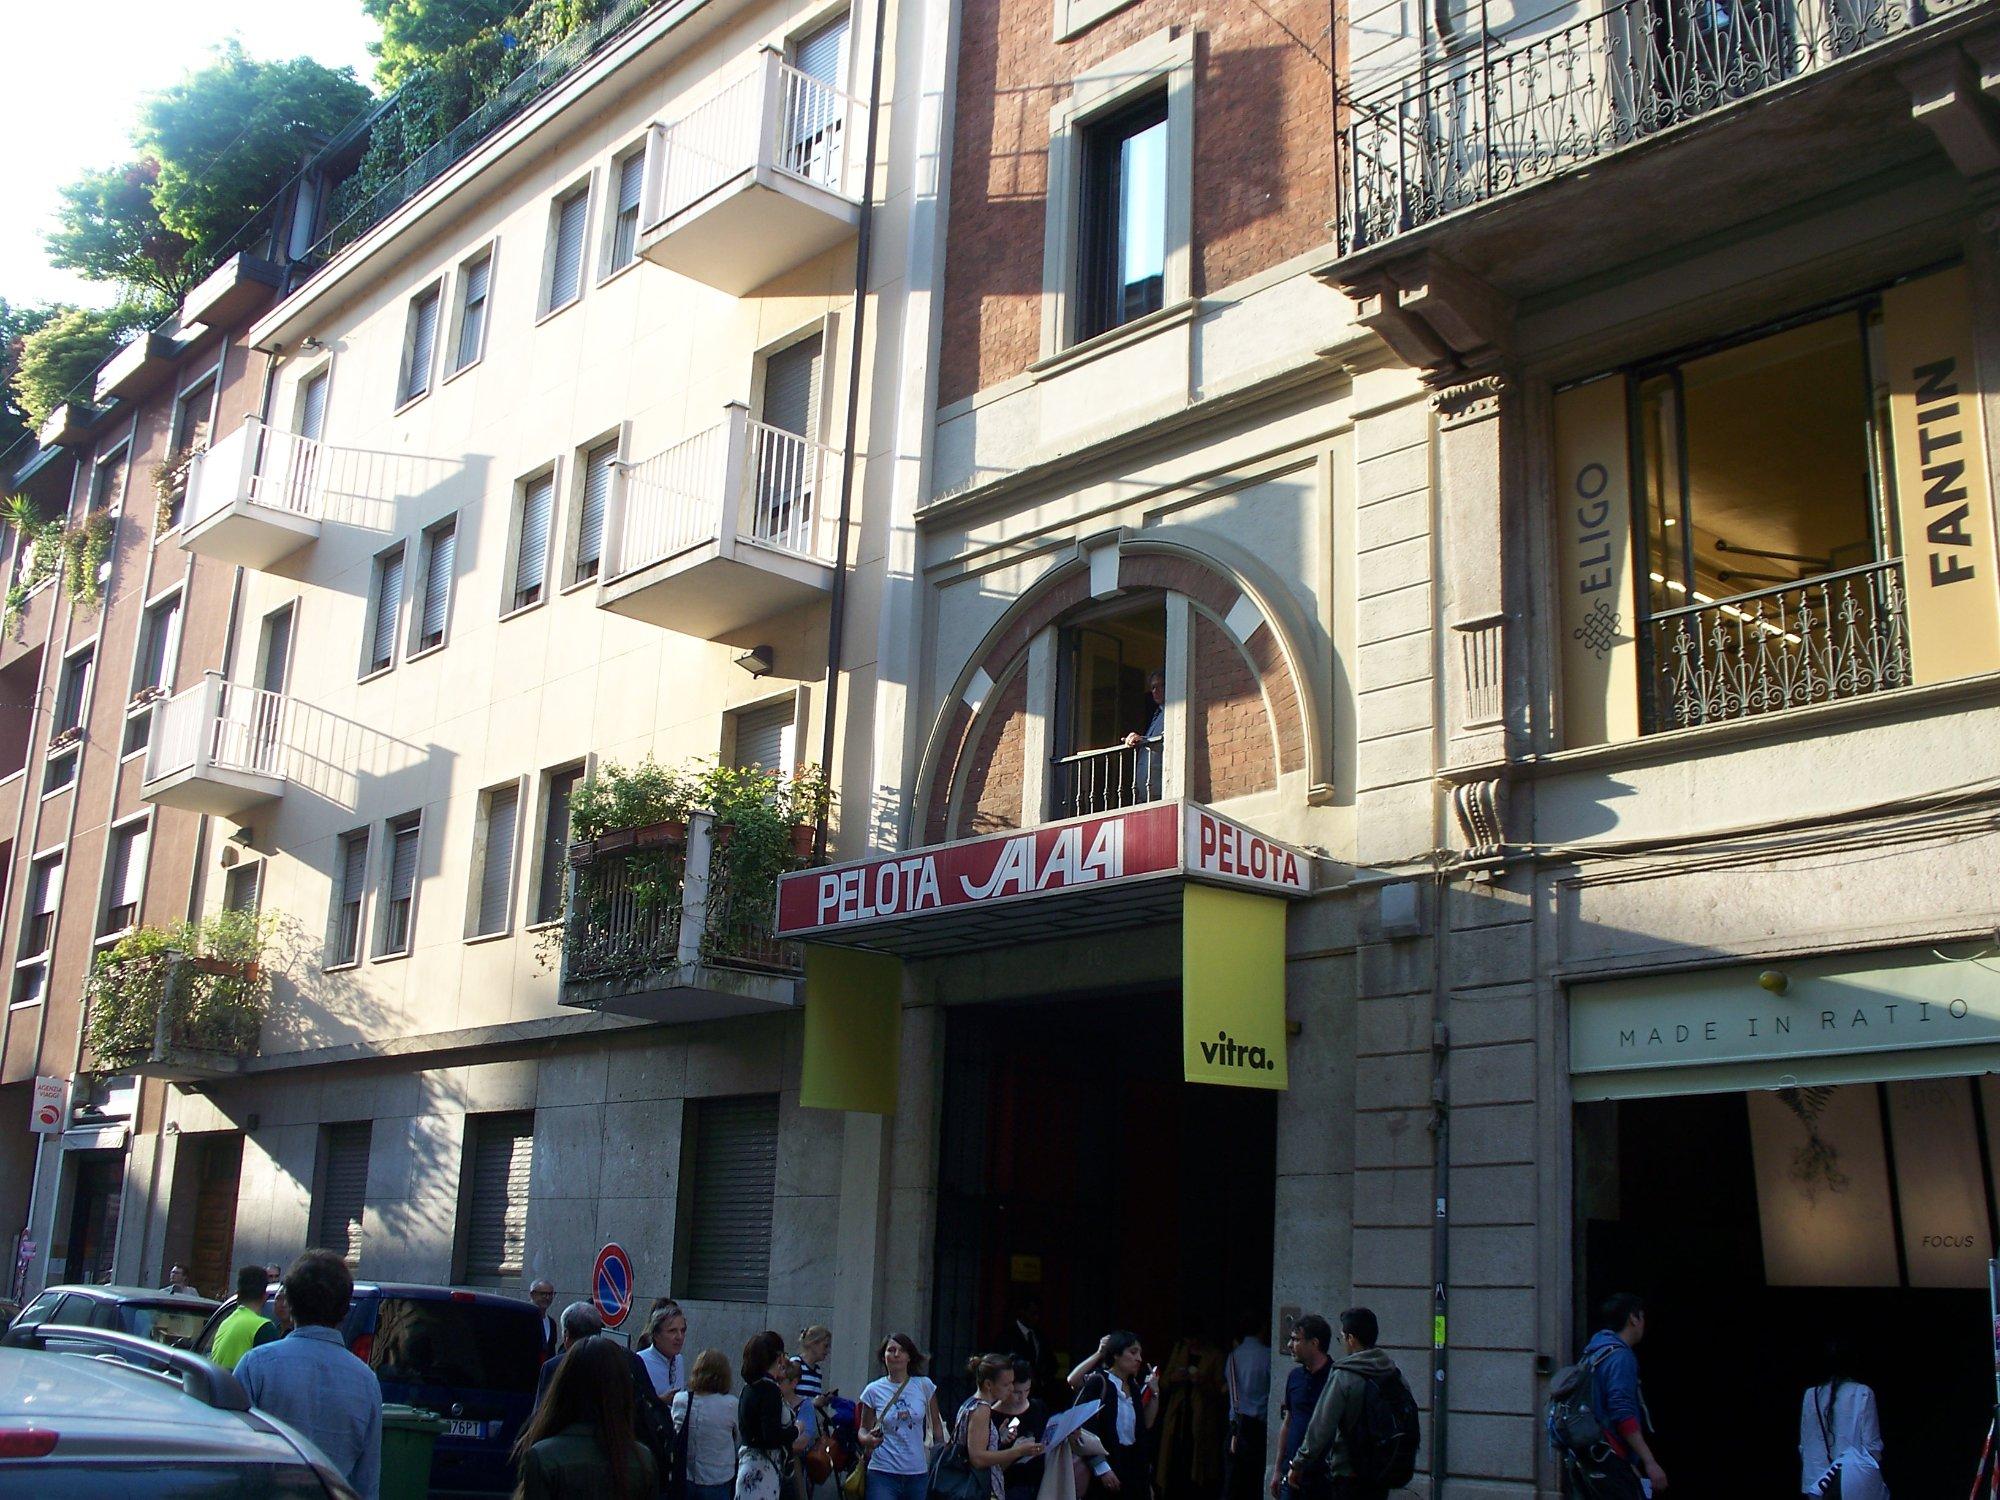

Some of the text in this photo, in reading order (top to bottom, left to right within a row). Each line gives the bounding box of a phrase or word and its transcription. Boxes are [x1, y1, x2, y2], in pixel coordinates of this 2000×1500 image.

[1913, 356, 1976, 588] FANTIN
[1576, 462, 1612, 594] ELIGO
[1200, 814, 1301, 887] PELOTA
[817, 856, 942, 925] PELOTA
[1200, 1030, 1275, 1070] vitra.
[1619, 998, 1968, 1047] MADE IN RATIO
[1922, 1235, 1974, 1248] FOCUS
